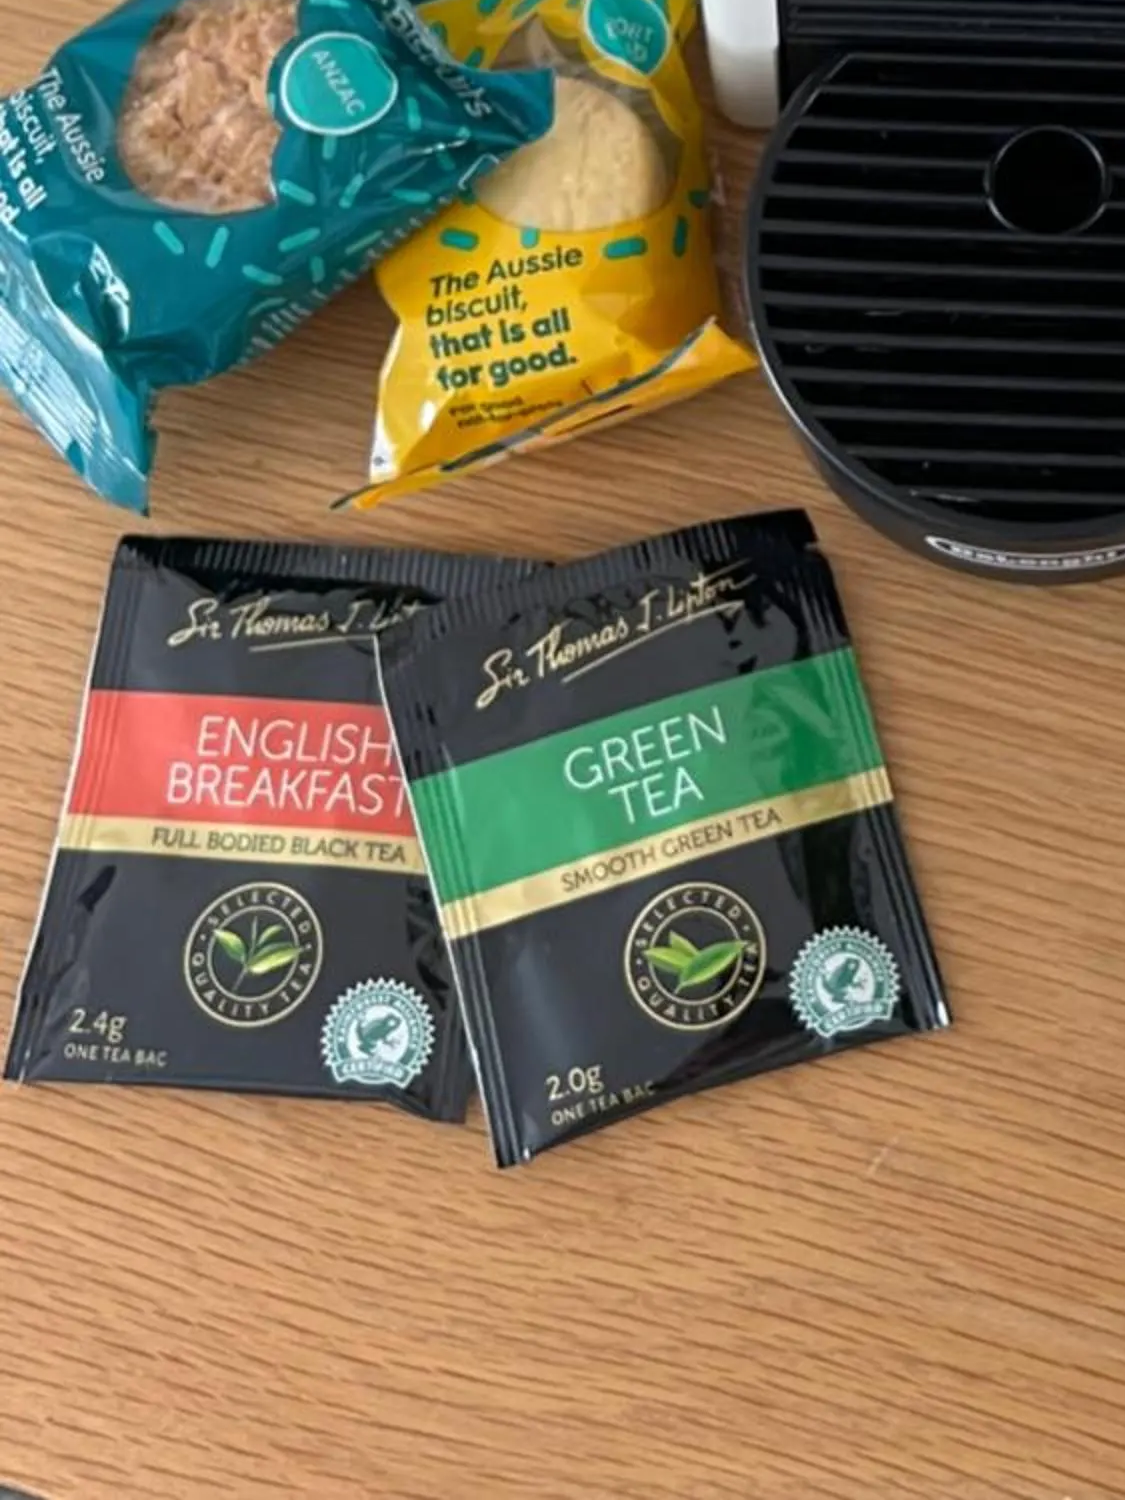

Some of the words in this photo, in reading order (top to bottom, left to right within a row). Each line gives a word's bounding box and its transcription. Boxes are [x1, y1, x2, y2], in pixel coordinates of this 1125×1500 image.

[311, 49, 366, 116] ANZAC
[38, 65, 67, 111] The
[55, 112, 106, 184] Aussie
[7, 147, 27, 180] is
[18, 176, 48, 211] all
[430, 270, 480, 298] The
[486, 244, 583, 284] Aussie
[426, 284, 528, 328] biscuit,
[430, 322, 493, 359] that
[498, 318, 526, 345] is
[532, 306, 571, 339] all
[437, 364, 483, 392] for
[489, 340, 578, 388] good.
[167, 597, 222, 647] Sir
[229, 594, 331, 639] Thomas
[475, 648, 531, 711] Sir
[526, 616, 629, 678] Thomas
[667, 559, 757, 622] Lipton
[197, 714, 394, 768] ENGLISH
[563, 704, 727, 790] GREEN
[166, 761, 409, 818] BREAKFAST
[607, 766, 705, 825] TEA
[151, 826, 200, 849] FULL
[206, 831, 285, 855] BODIED
[291, 838, 362, 861] BLACK
[365, 840, 407, 863] TEA
[560, 845, 657, 894] SMOOTH
[660, 819, 734, 859] GREEN
[736, 806, 783, 835] TEA
[207, 890, 312, 934] SELECTED
[635, 890, 742, 947] SELECTED
[191, 952, 270, 1018] QUALITY
[279, 962, 312, 1004] TEA
[636, 976, 736, 1022] QUALITY
[63, 1041, 99, 1061] ONE
[102, 1045, 132, 1063] TEA
[68, 1007, 128, 1043] 2.4g
[545, 1064, 604, 1100] 2.0g
[551, 1101, 585, 1125] ONE
[588, 1091, 620, 1113] TEA
